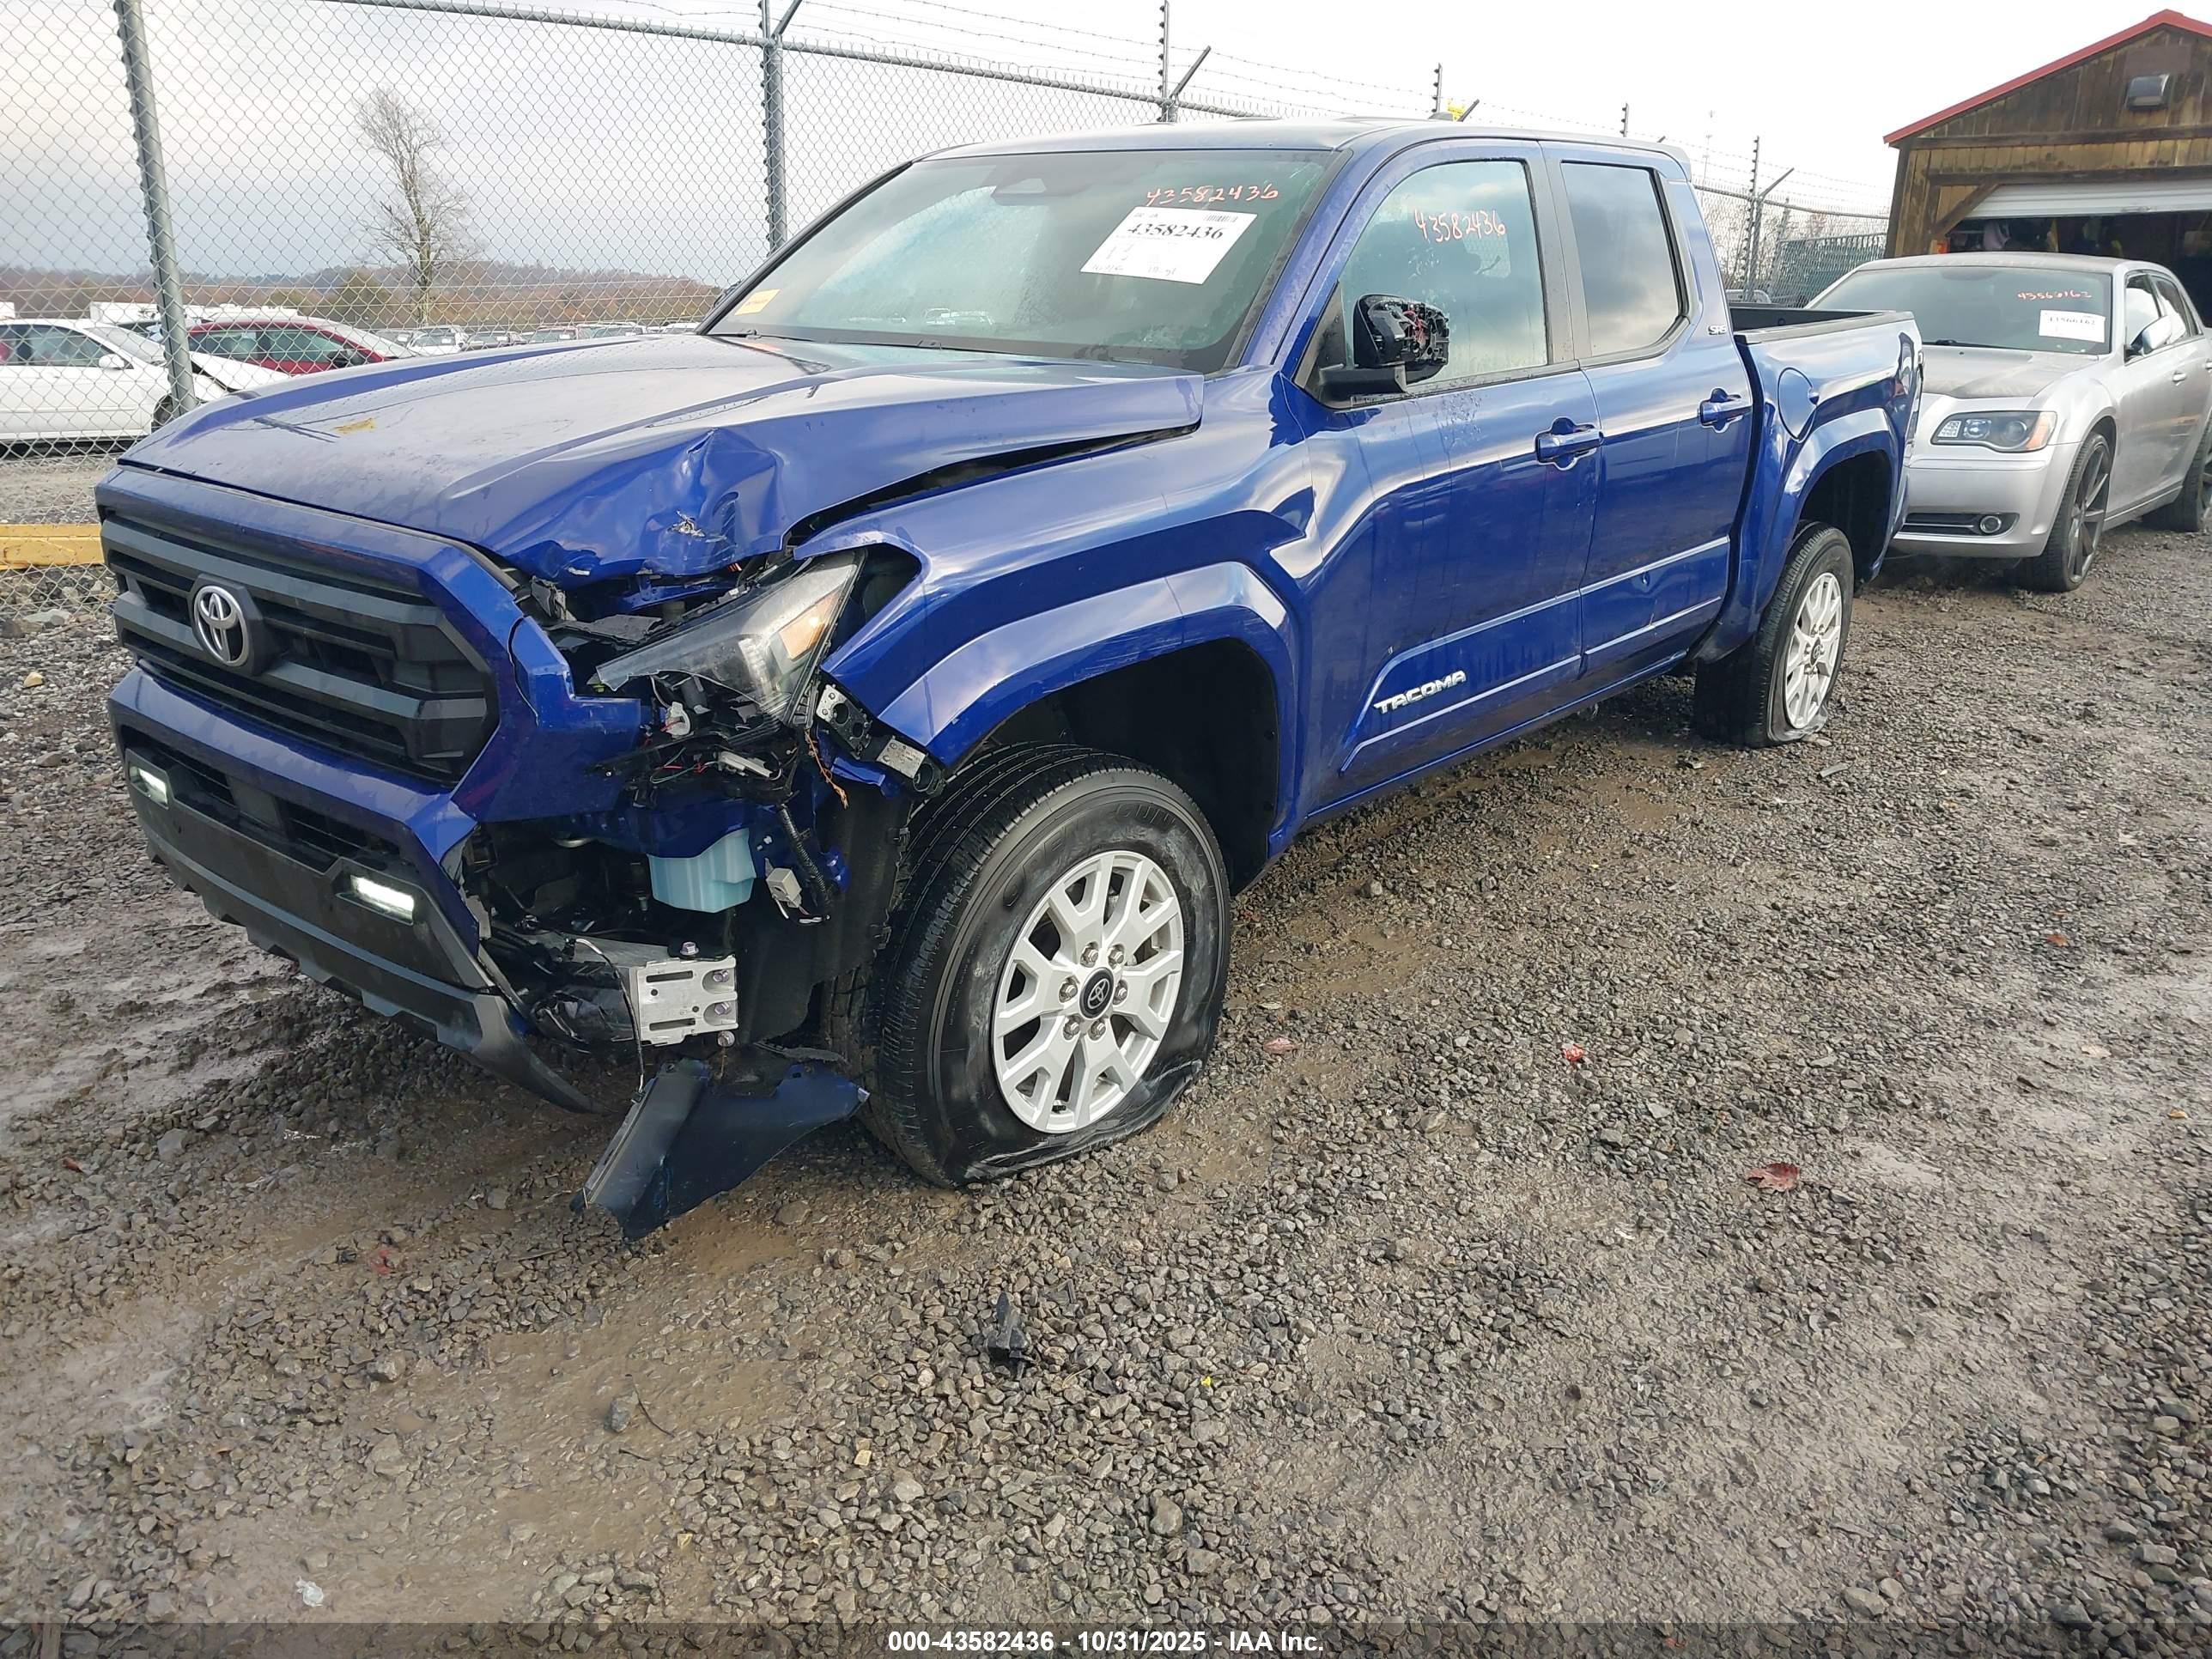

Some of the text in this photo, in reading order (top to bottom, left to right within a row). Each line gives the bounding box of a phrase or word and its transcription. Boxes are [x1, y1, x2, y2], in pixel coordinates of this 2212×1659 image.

[1146, 184, 1279, 206] 43582436
[1127, 222, 1224, 240] 43582436
[1414, 209, 1505, 242] 43582436
[1374, 670, 1467, 714] TACOMA
